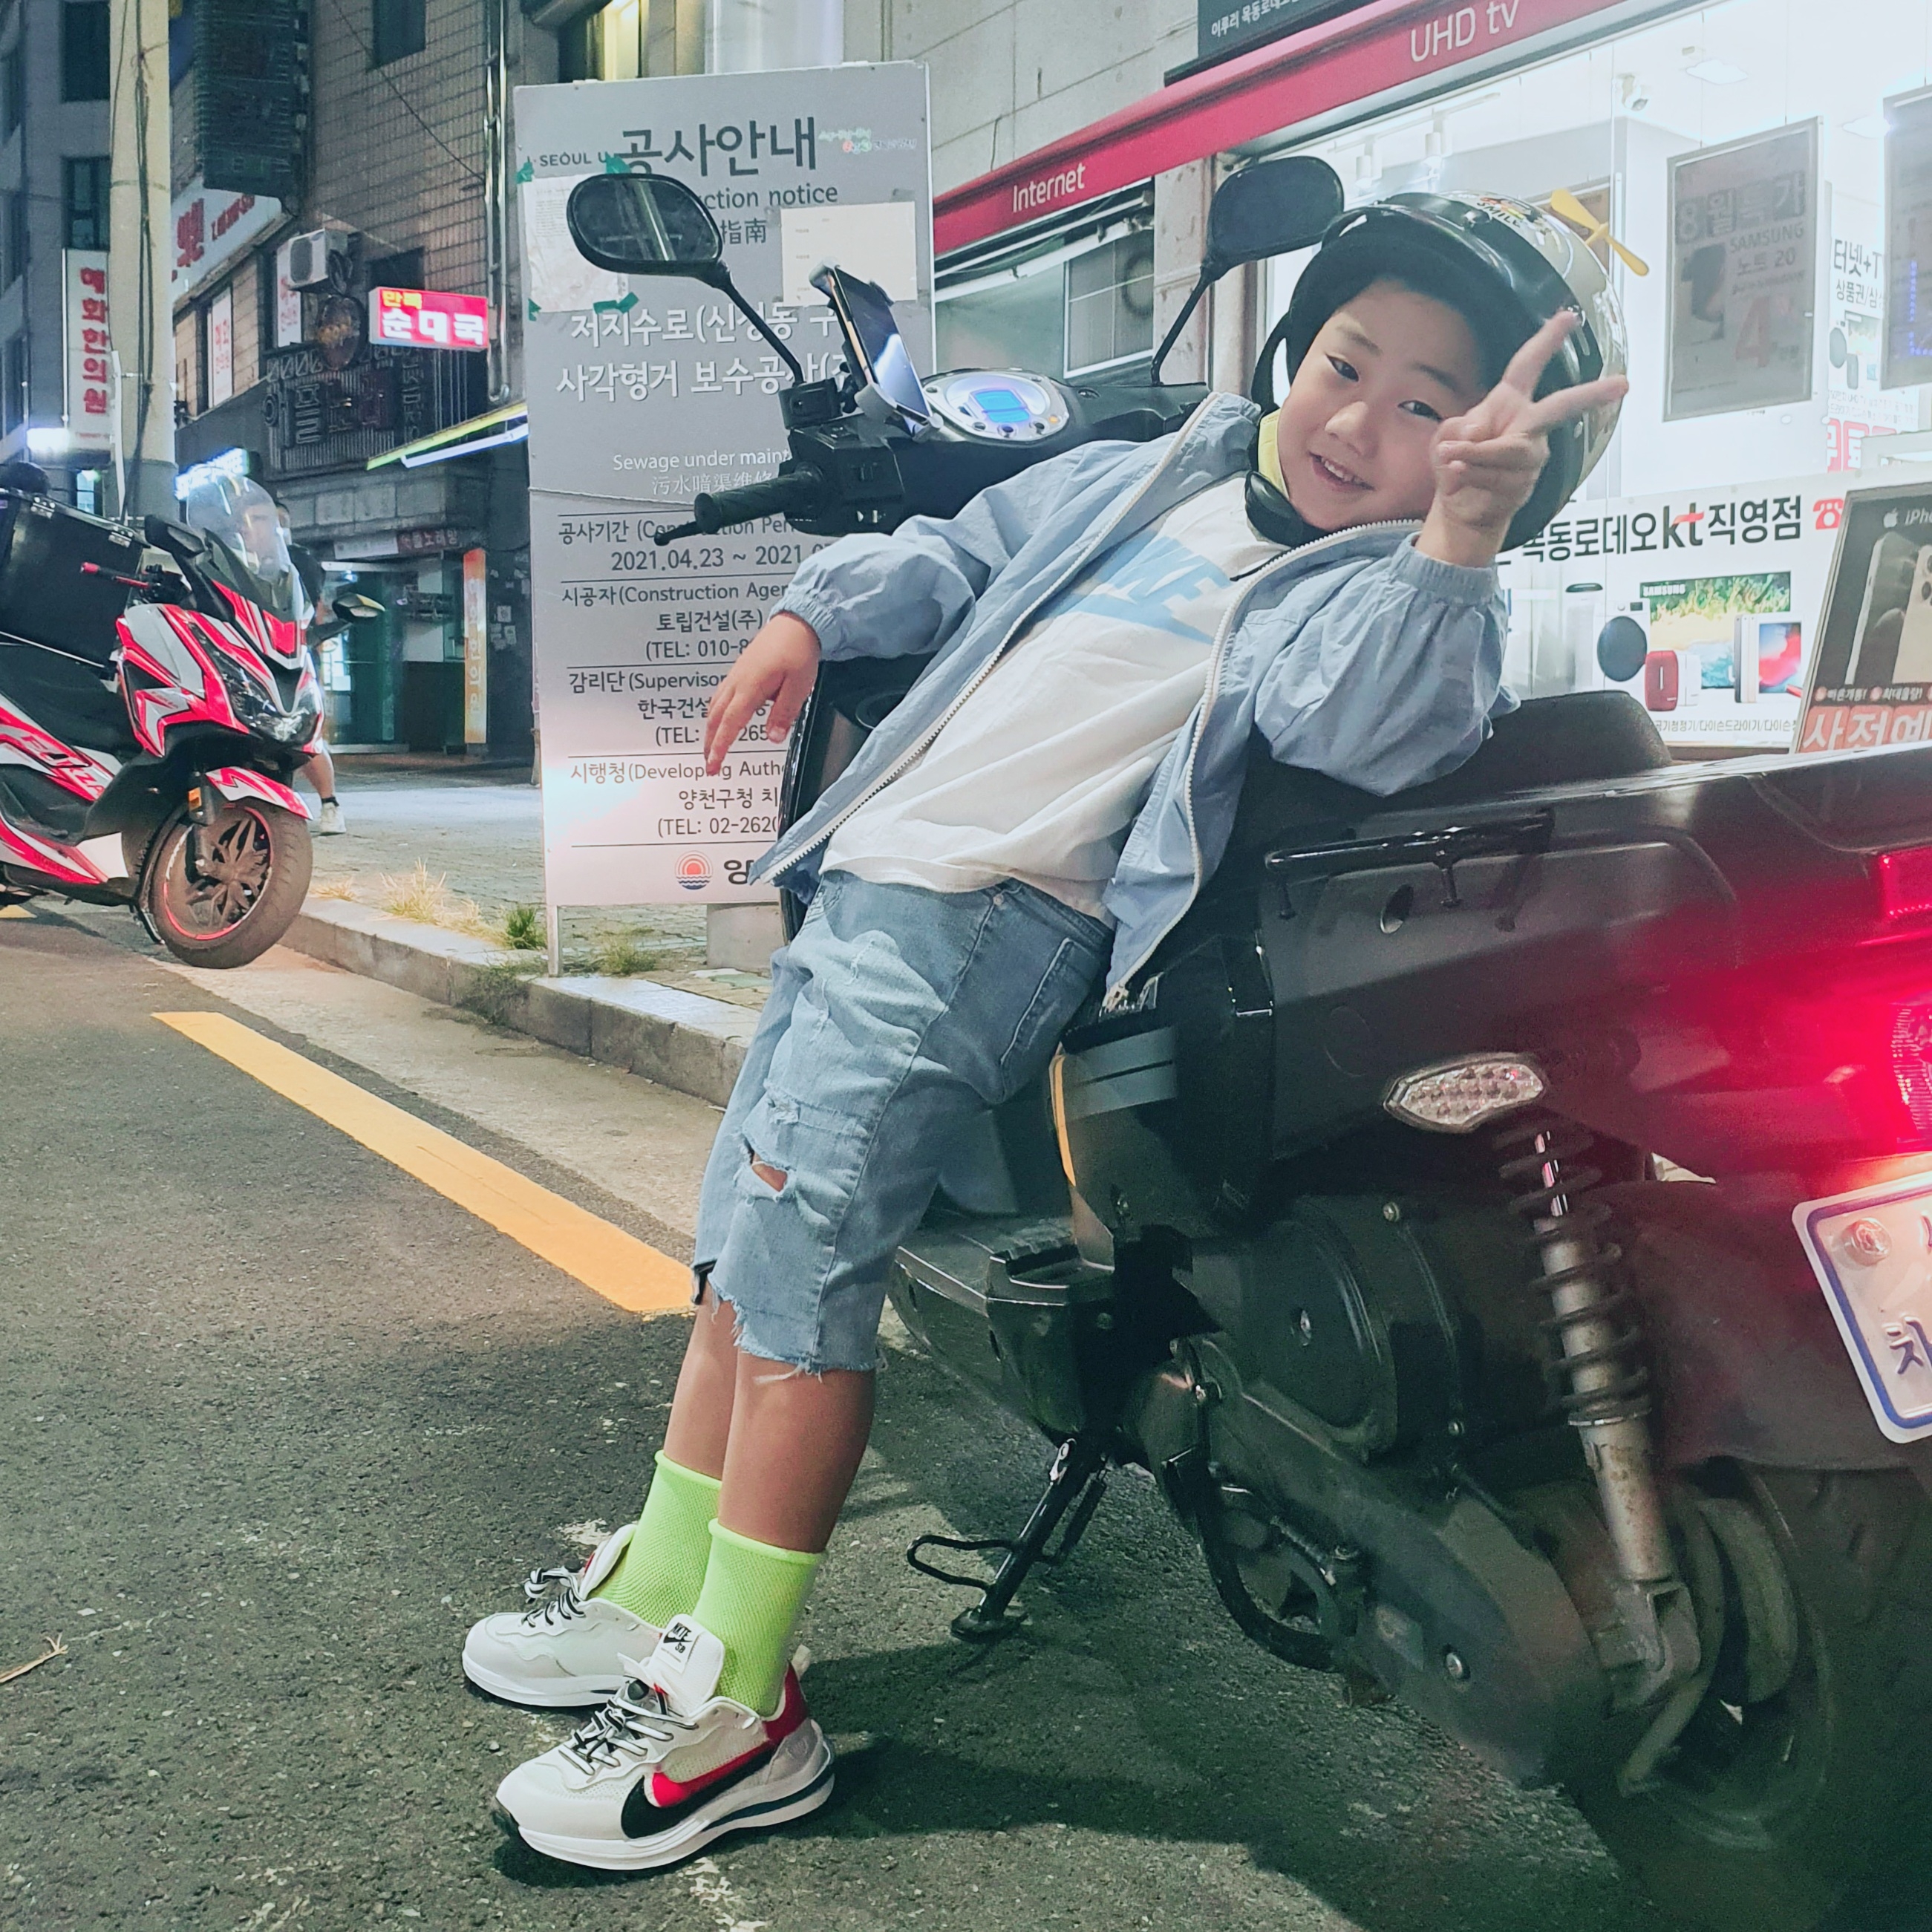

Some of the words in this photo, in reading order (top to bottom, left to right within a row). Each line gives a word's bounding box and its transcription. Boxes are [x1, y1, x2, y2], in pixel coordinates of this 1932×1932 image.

[1412, 7, 1476, 62] UHD
[1486, 0, 1520, 35] tv
[614, 116, 816, 177] 공사안내
[539, 151, 593, 167] SEOUL
[768, 182, 838, 206] notice
[1013, 162, 1086, 213] Internet
[719, 217, 768, 245] 指南
[1729, 223, 1805, 254] SAMSUNG
[555, 359, 679, 402] 사각형거
[613, 454, 680, 472] Sewage
[685, 449, 735, 468] under
[740, 447, 792, 466] maint
[558, 520, 630, 545] 공사기간
[611, 547, 725, 571] 2021.04.23
[656, 609, 763, 633] 토립건설(주)
[645, 640, 691, 662] (TEL:
[655, 725, 699, 746] (TEL:
[570, 761, 732, 784] 시행청(Developg
[739, 760, 784, 777] Auth
[679, 787, 753, 811] 양천구청
[658, 817, 701, 838] (TEL:
